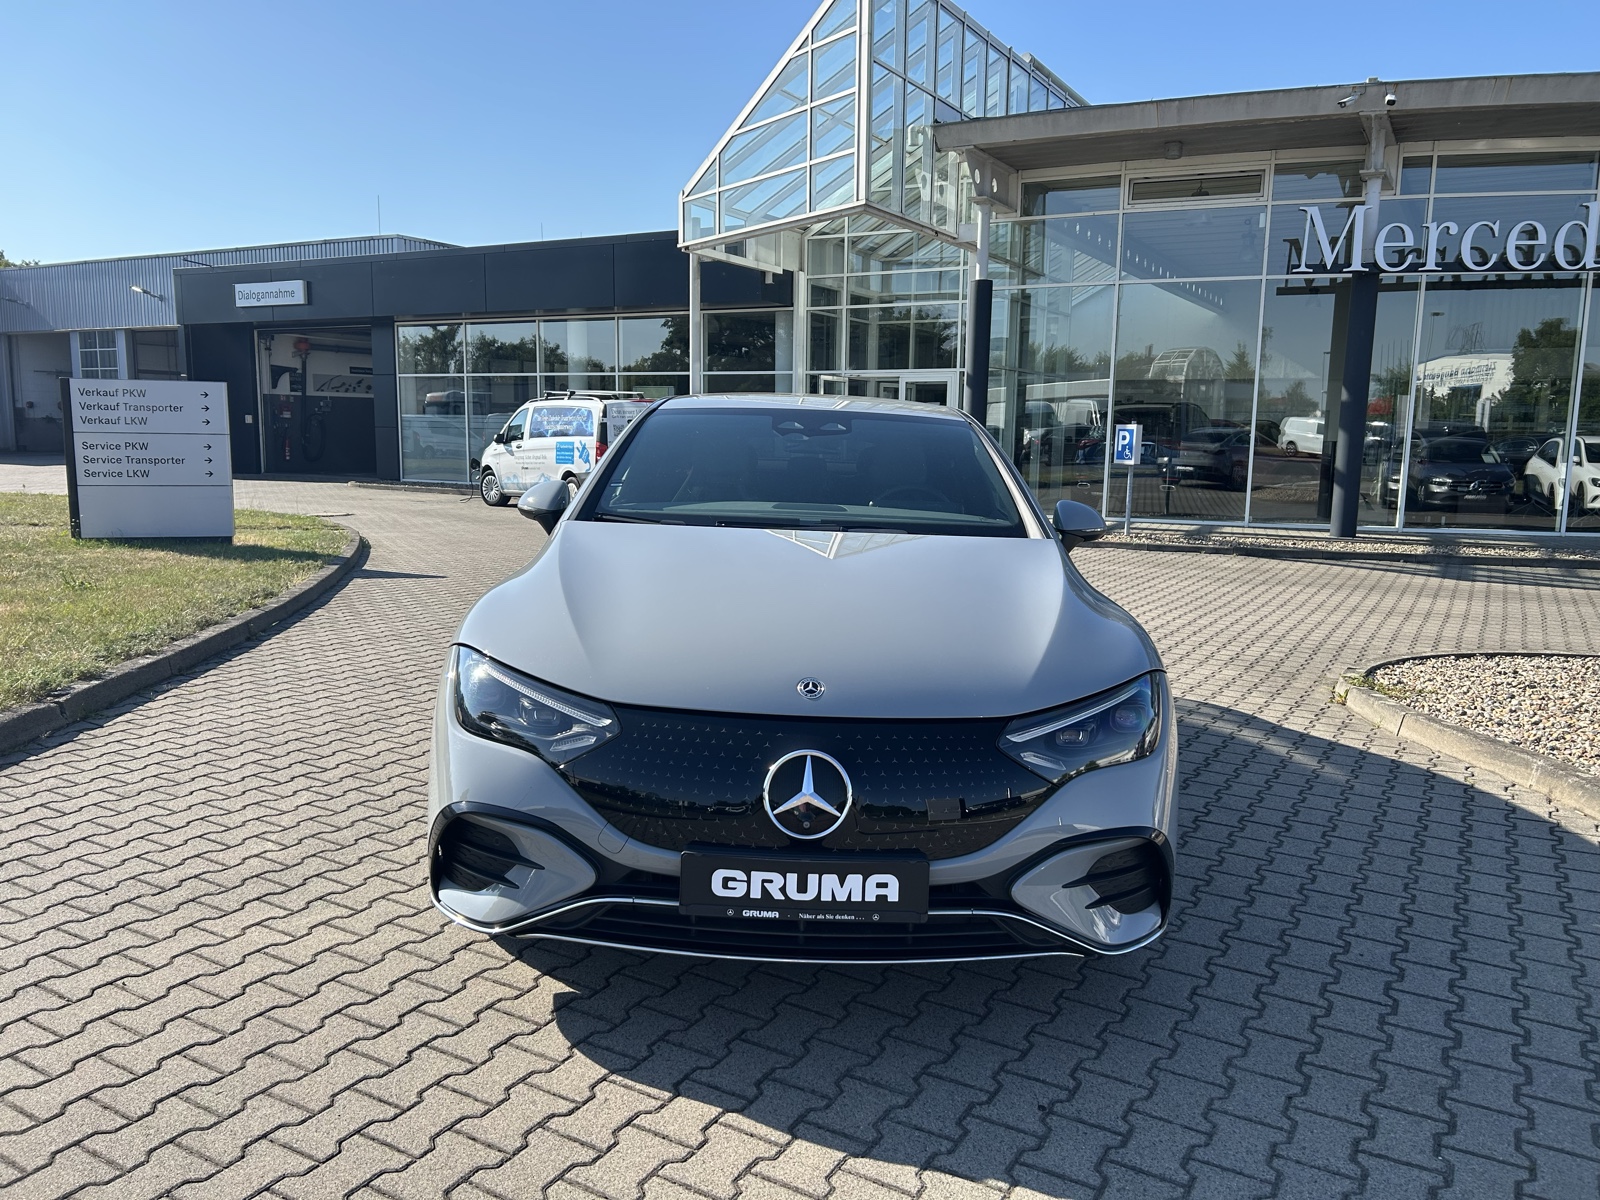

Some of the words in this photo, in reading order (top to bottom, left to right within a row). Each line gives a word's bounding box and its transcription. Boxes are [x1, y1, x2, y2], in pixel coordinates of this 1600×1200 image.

[1291, 201, 1600, 273] Merced
[237, 288, 296, 302] Dialogannahme
[77, 387, 119, 397] Verkauf
[122, 388, 147, 398] PKW
[78, 401, 120, 411] Verkauf
[123, 402, 184, 414] Transporter
[80, 415, 121, 425] Verkauf
[124, 416, 148, 426] LKW
[81, 441, 122, 451] Service
[124, 441, 149, 451] PKW
[1118, 430, 1131, 452] P
[82, 455, 123, 464] Service
[125, 455, 186, 467] Transporter
[83, 469, 123, 478] Service
[126, 469, 150, 478] LKW
[711, 868, 900, 902] GRUMA
[742, 909, 779, 919] GRUMA
